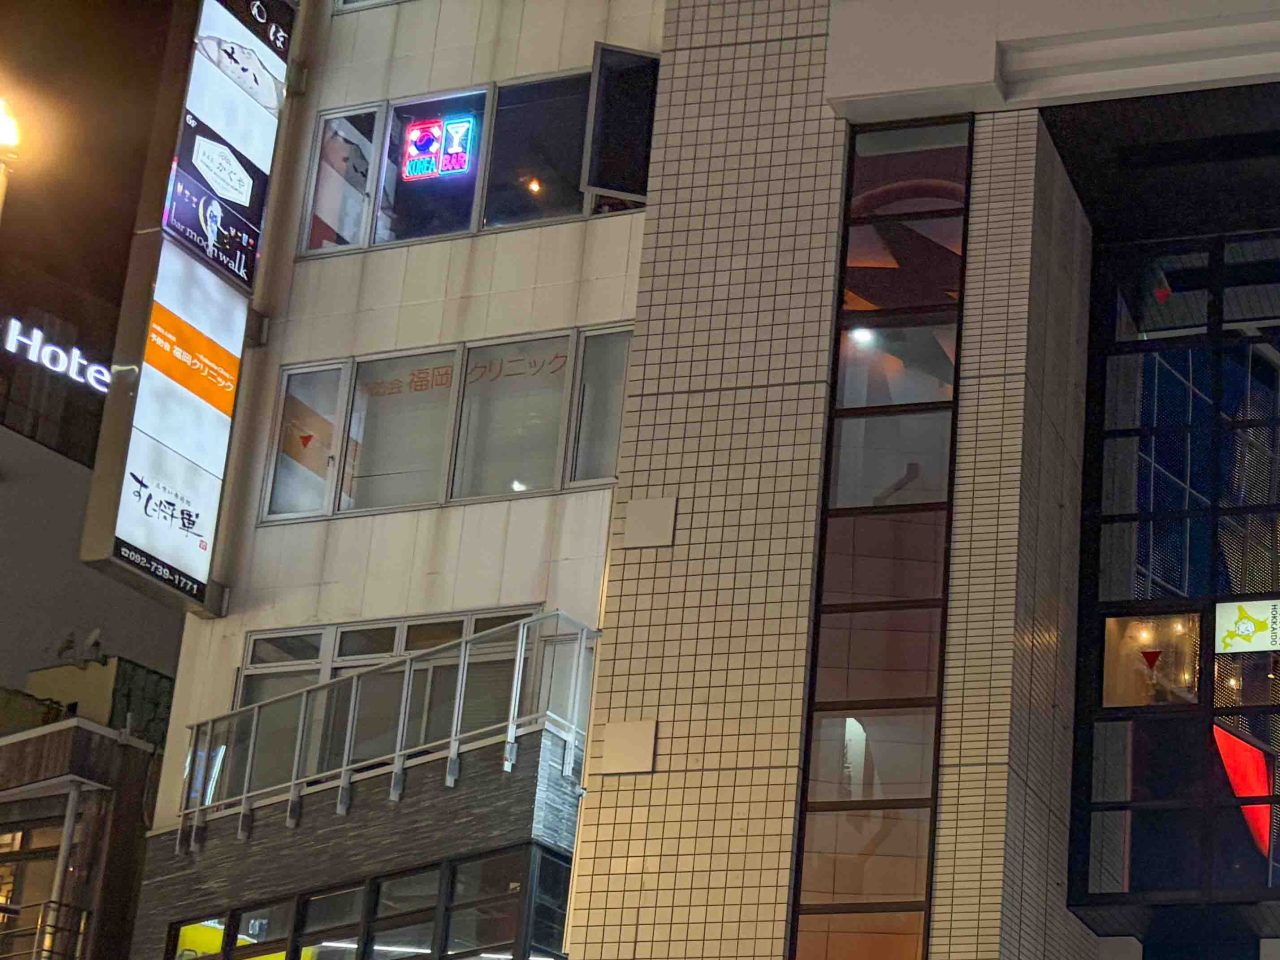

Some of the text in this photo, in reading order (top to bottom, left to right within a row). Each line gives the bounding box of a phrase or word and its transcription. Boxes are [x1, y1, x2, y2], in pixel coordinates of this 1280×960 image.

[406, 157, 436, 176] KOREA
[442, 152, 467, 171] BAR
[1271, 604, 1279, 646] HOKKAIDO
